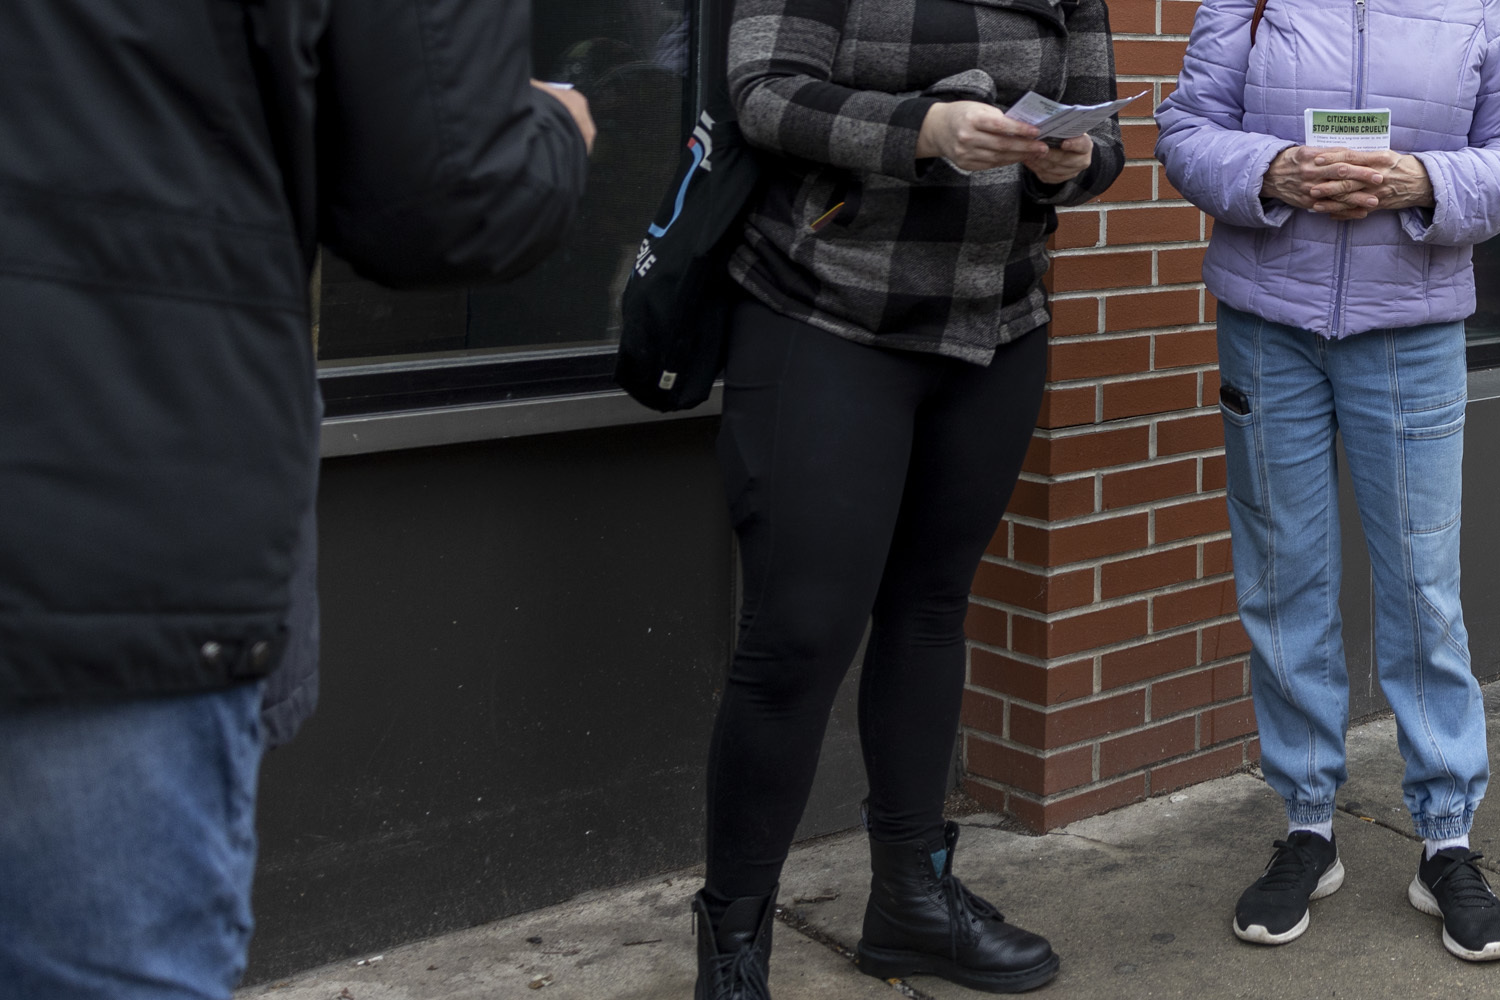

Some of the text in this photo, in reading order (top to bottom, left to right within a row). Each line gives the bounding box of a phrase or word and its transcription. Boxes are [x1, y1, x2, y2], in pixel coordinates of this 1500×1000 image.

[1326, 115, 1378, 124] CITIZENS BANK:
[1313, 124, 1389, 133] STOP FUNDING CRUELTY
